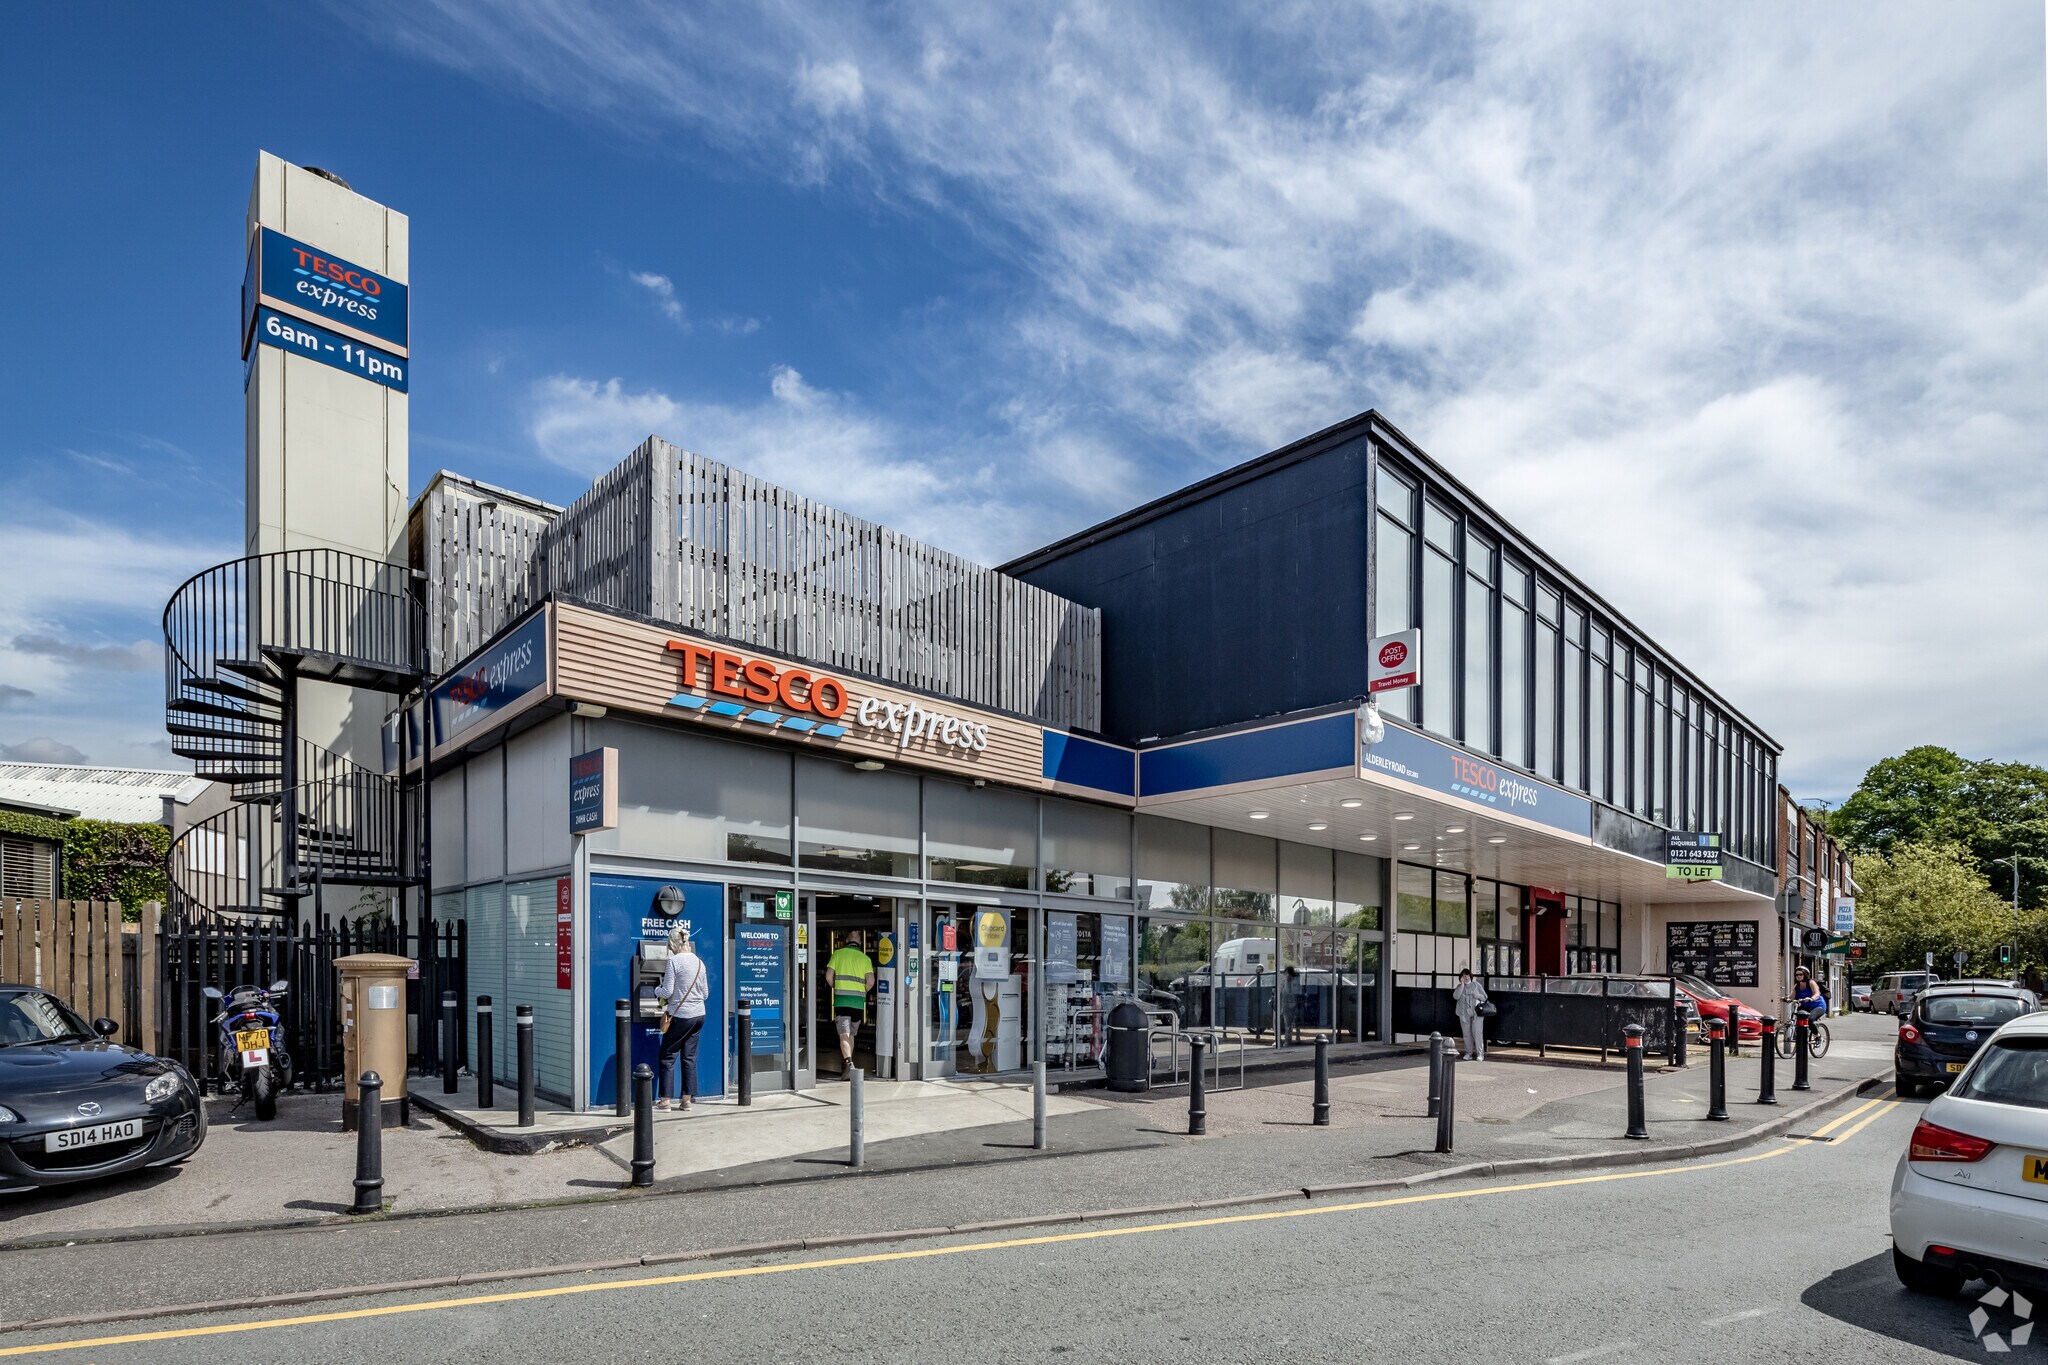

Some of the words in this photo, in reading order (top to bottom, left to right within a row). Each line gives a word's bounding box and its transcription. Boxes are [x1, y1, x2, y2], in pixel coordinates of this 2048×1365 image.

[292, 247, 381, 297] TESCO
[296, 280, 378, 321] express
[266, 316, 318, 351] 6am
[341, 344, 402, 382] 11pm
[1384, 645, 1402, 655] POST
[1381, 652, 1404, 664] OFFICE
[449, 666, 487, 707] TESCO
[490, 639, 532, 693] express
[1377, 679, 1392, 687] Travel
[1392, 677, 1409, 685] Money
[666, 639, 849, 718] TESCO
[857, 697, 989, 751] express
[1365, 753, 1392, 770] ALDERLEY
[1392, 761, 1405, 775] ROAD
[1451, 755, 1497, 792] TESCO
[1499, 778, 1538, 807] express
[573, 784, 600, 804] express
[575, 814, 586, 825] 24HR
[586, 811, 598, 823] CASH
[1689, 850, 1702, 858] 643
[1677, 867, 1691, 876] TO
[1695, 868, 1712, 876] LET
[641, 918, 665, 928] FREE
[665, 919, 690, 929] CASH
[642, 929, 690, 937] WITHDRS
[1823, 939, 1849, 951] SUBWAY
[763, 998, 779, 1006] 11pm
[238, 1030, 267, 1042] MF70
[242, 1040, 265, 1049] DHJ
[249, 1051, 262, 1063] L
[57, 1128, 97, 1148] SD14
[102, 1123, 134, 1141] HAO
[1954, 1169, 1971, 1179] A1
[2033, 1160, 2048, 1180] M
